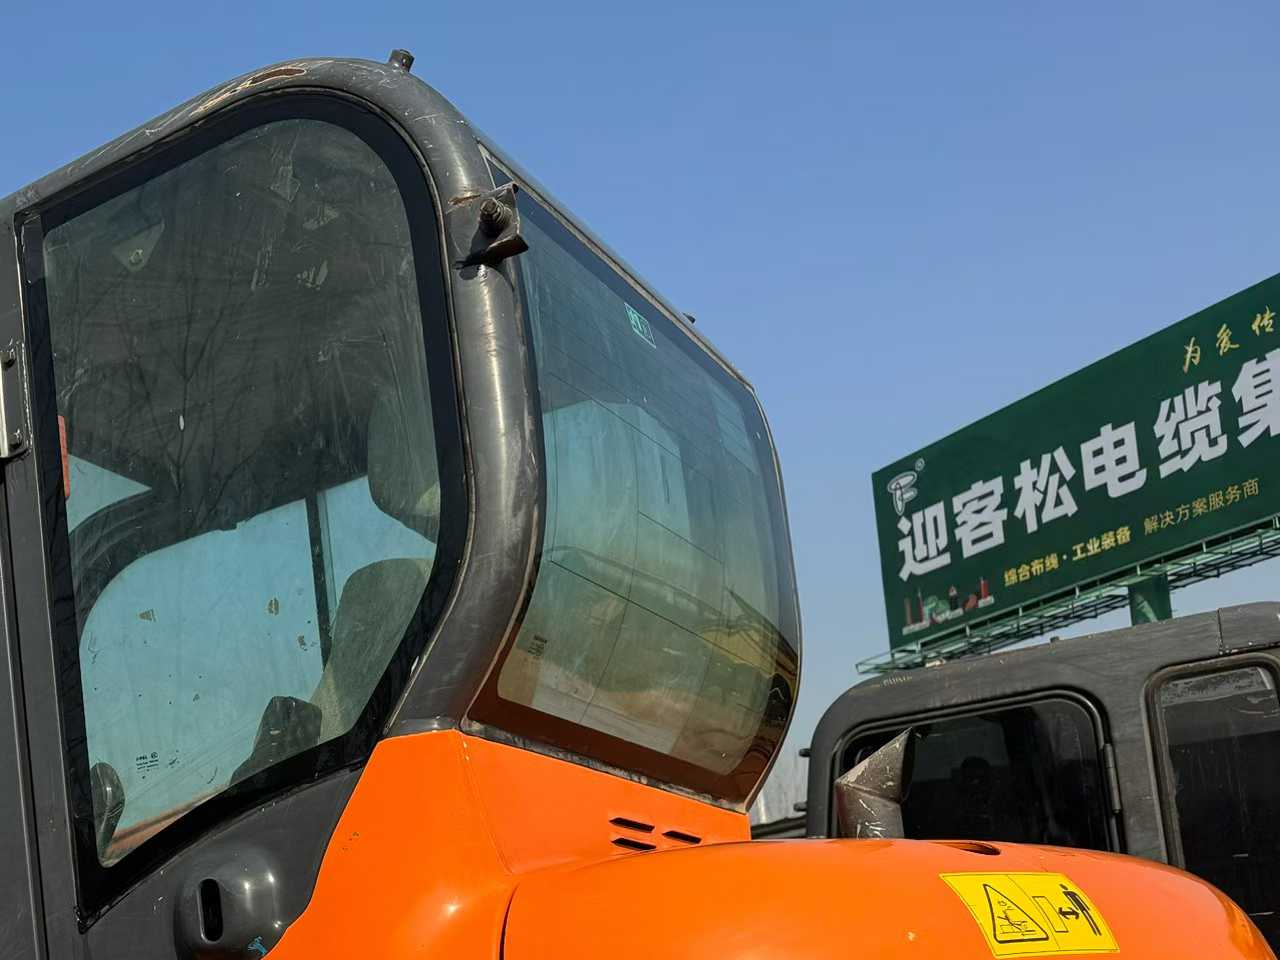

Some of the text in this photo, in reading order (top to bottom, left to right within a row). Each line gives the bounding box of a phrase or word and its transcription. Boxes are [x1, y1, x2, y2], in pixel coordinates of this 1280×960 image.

[897, 348, 1280, 582] 迎客松电缆集
[1143, 478, 1260, 535] 解决方案服务商
